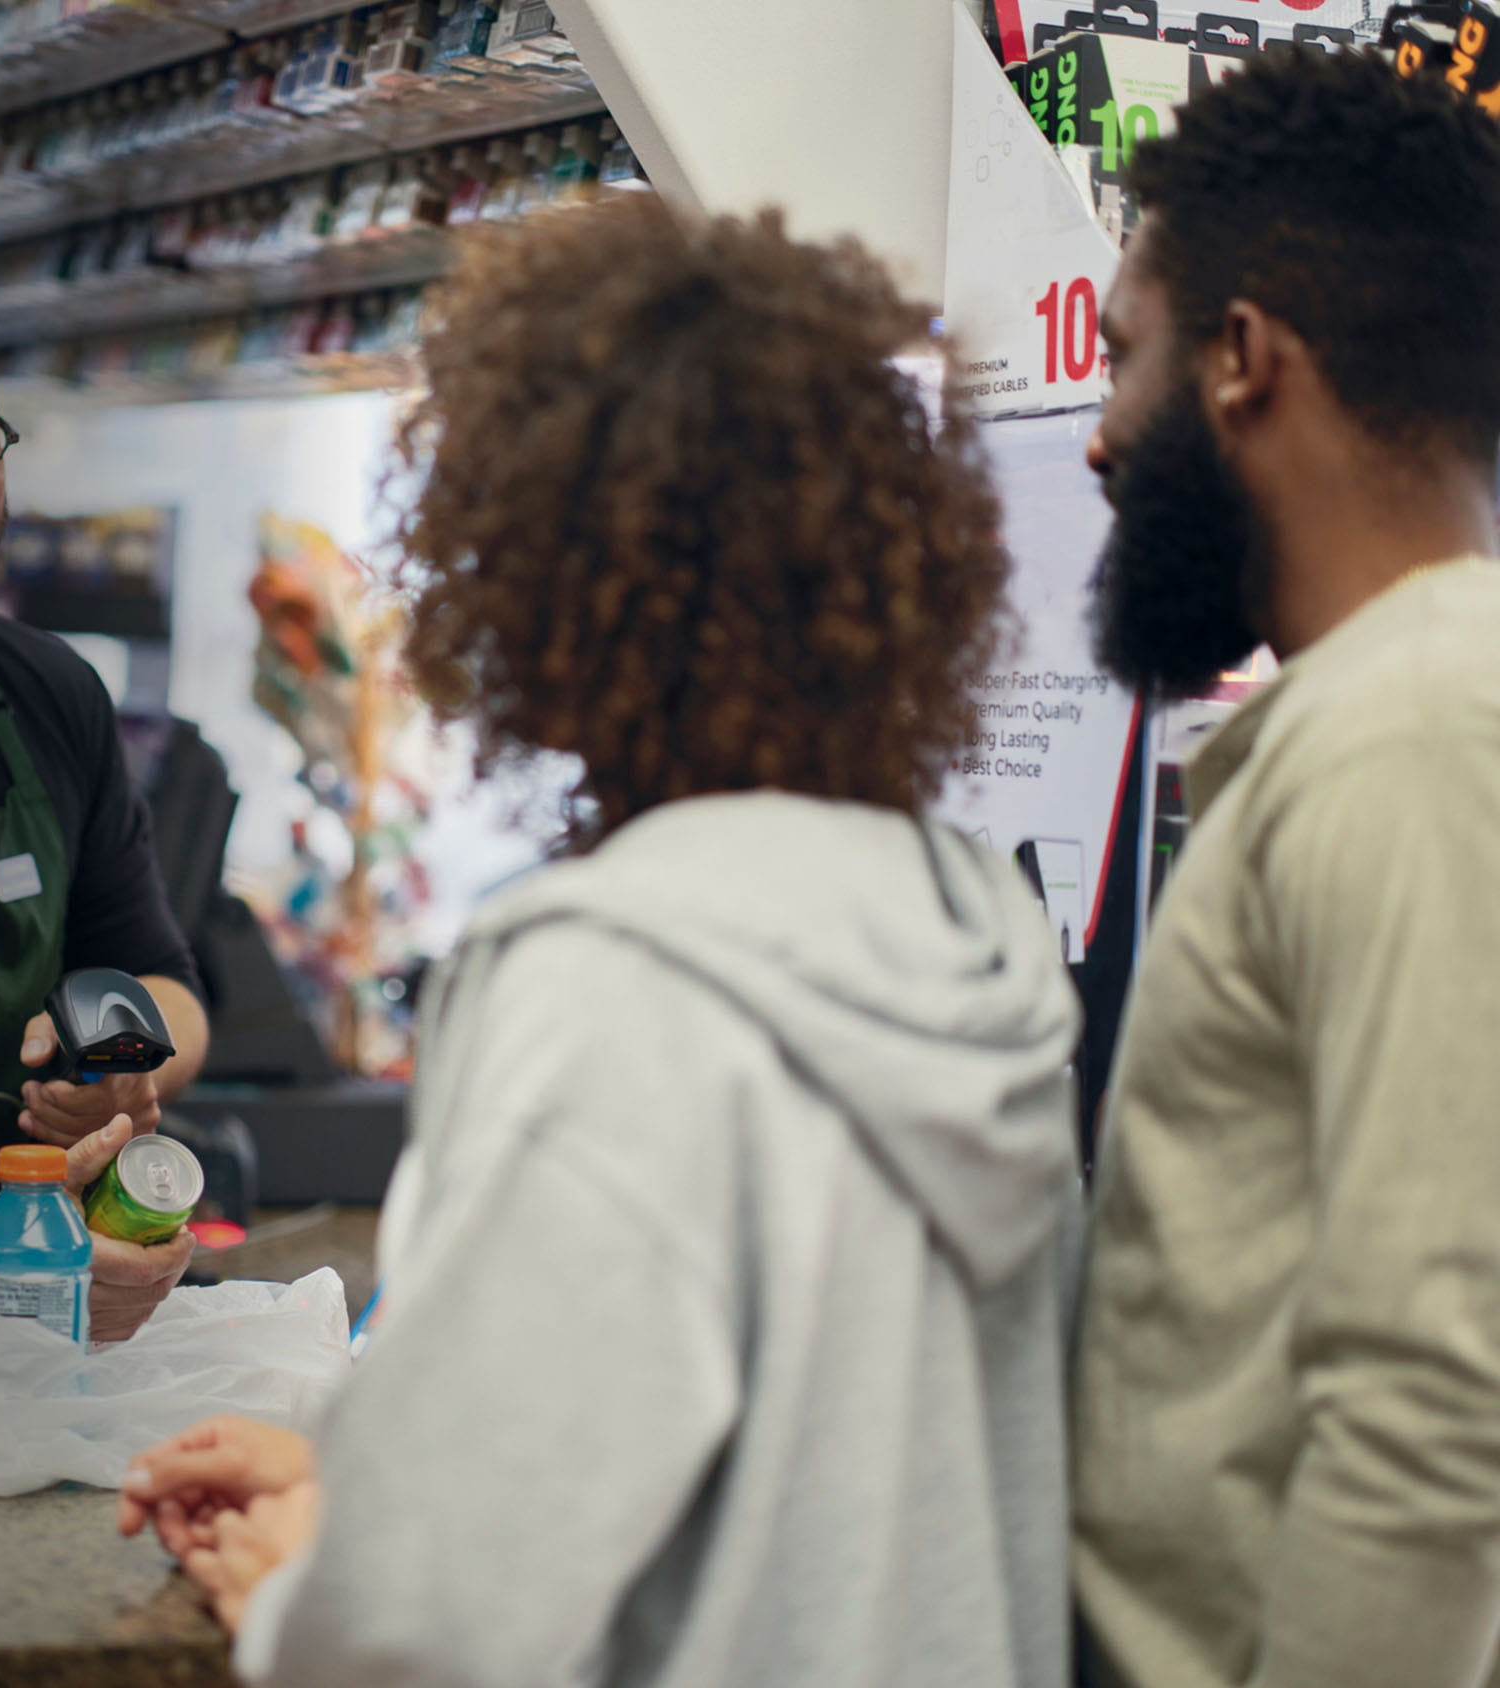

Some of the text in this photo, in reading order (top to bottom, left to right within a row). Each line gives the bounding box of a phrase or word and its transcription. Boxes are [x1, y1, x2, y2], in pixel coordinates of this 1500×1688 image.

[1445, 16, 1487, 96] NG
[1030, 67, 1049, 131] NG
[1056, 51, 1077, 149] ONG
[1090, 99, 1159, 172] 10
[1036, 276, 1099, 384] 10
[967, 358, 1008, 375] PREMIUM
[993, 378, 1029, 394] CABLES
[1043, 671, 1109, 695] Charging
[1032, 700, 1083, 724] Quality
[1000, 729, 1050, 753] Lasting
[962, 757, 1042, 778] Best Choice
